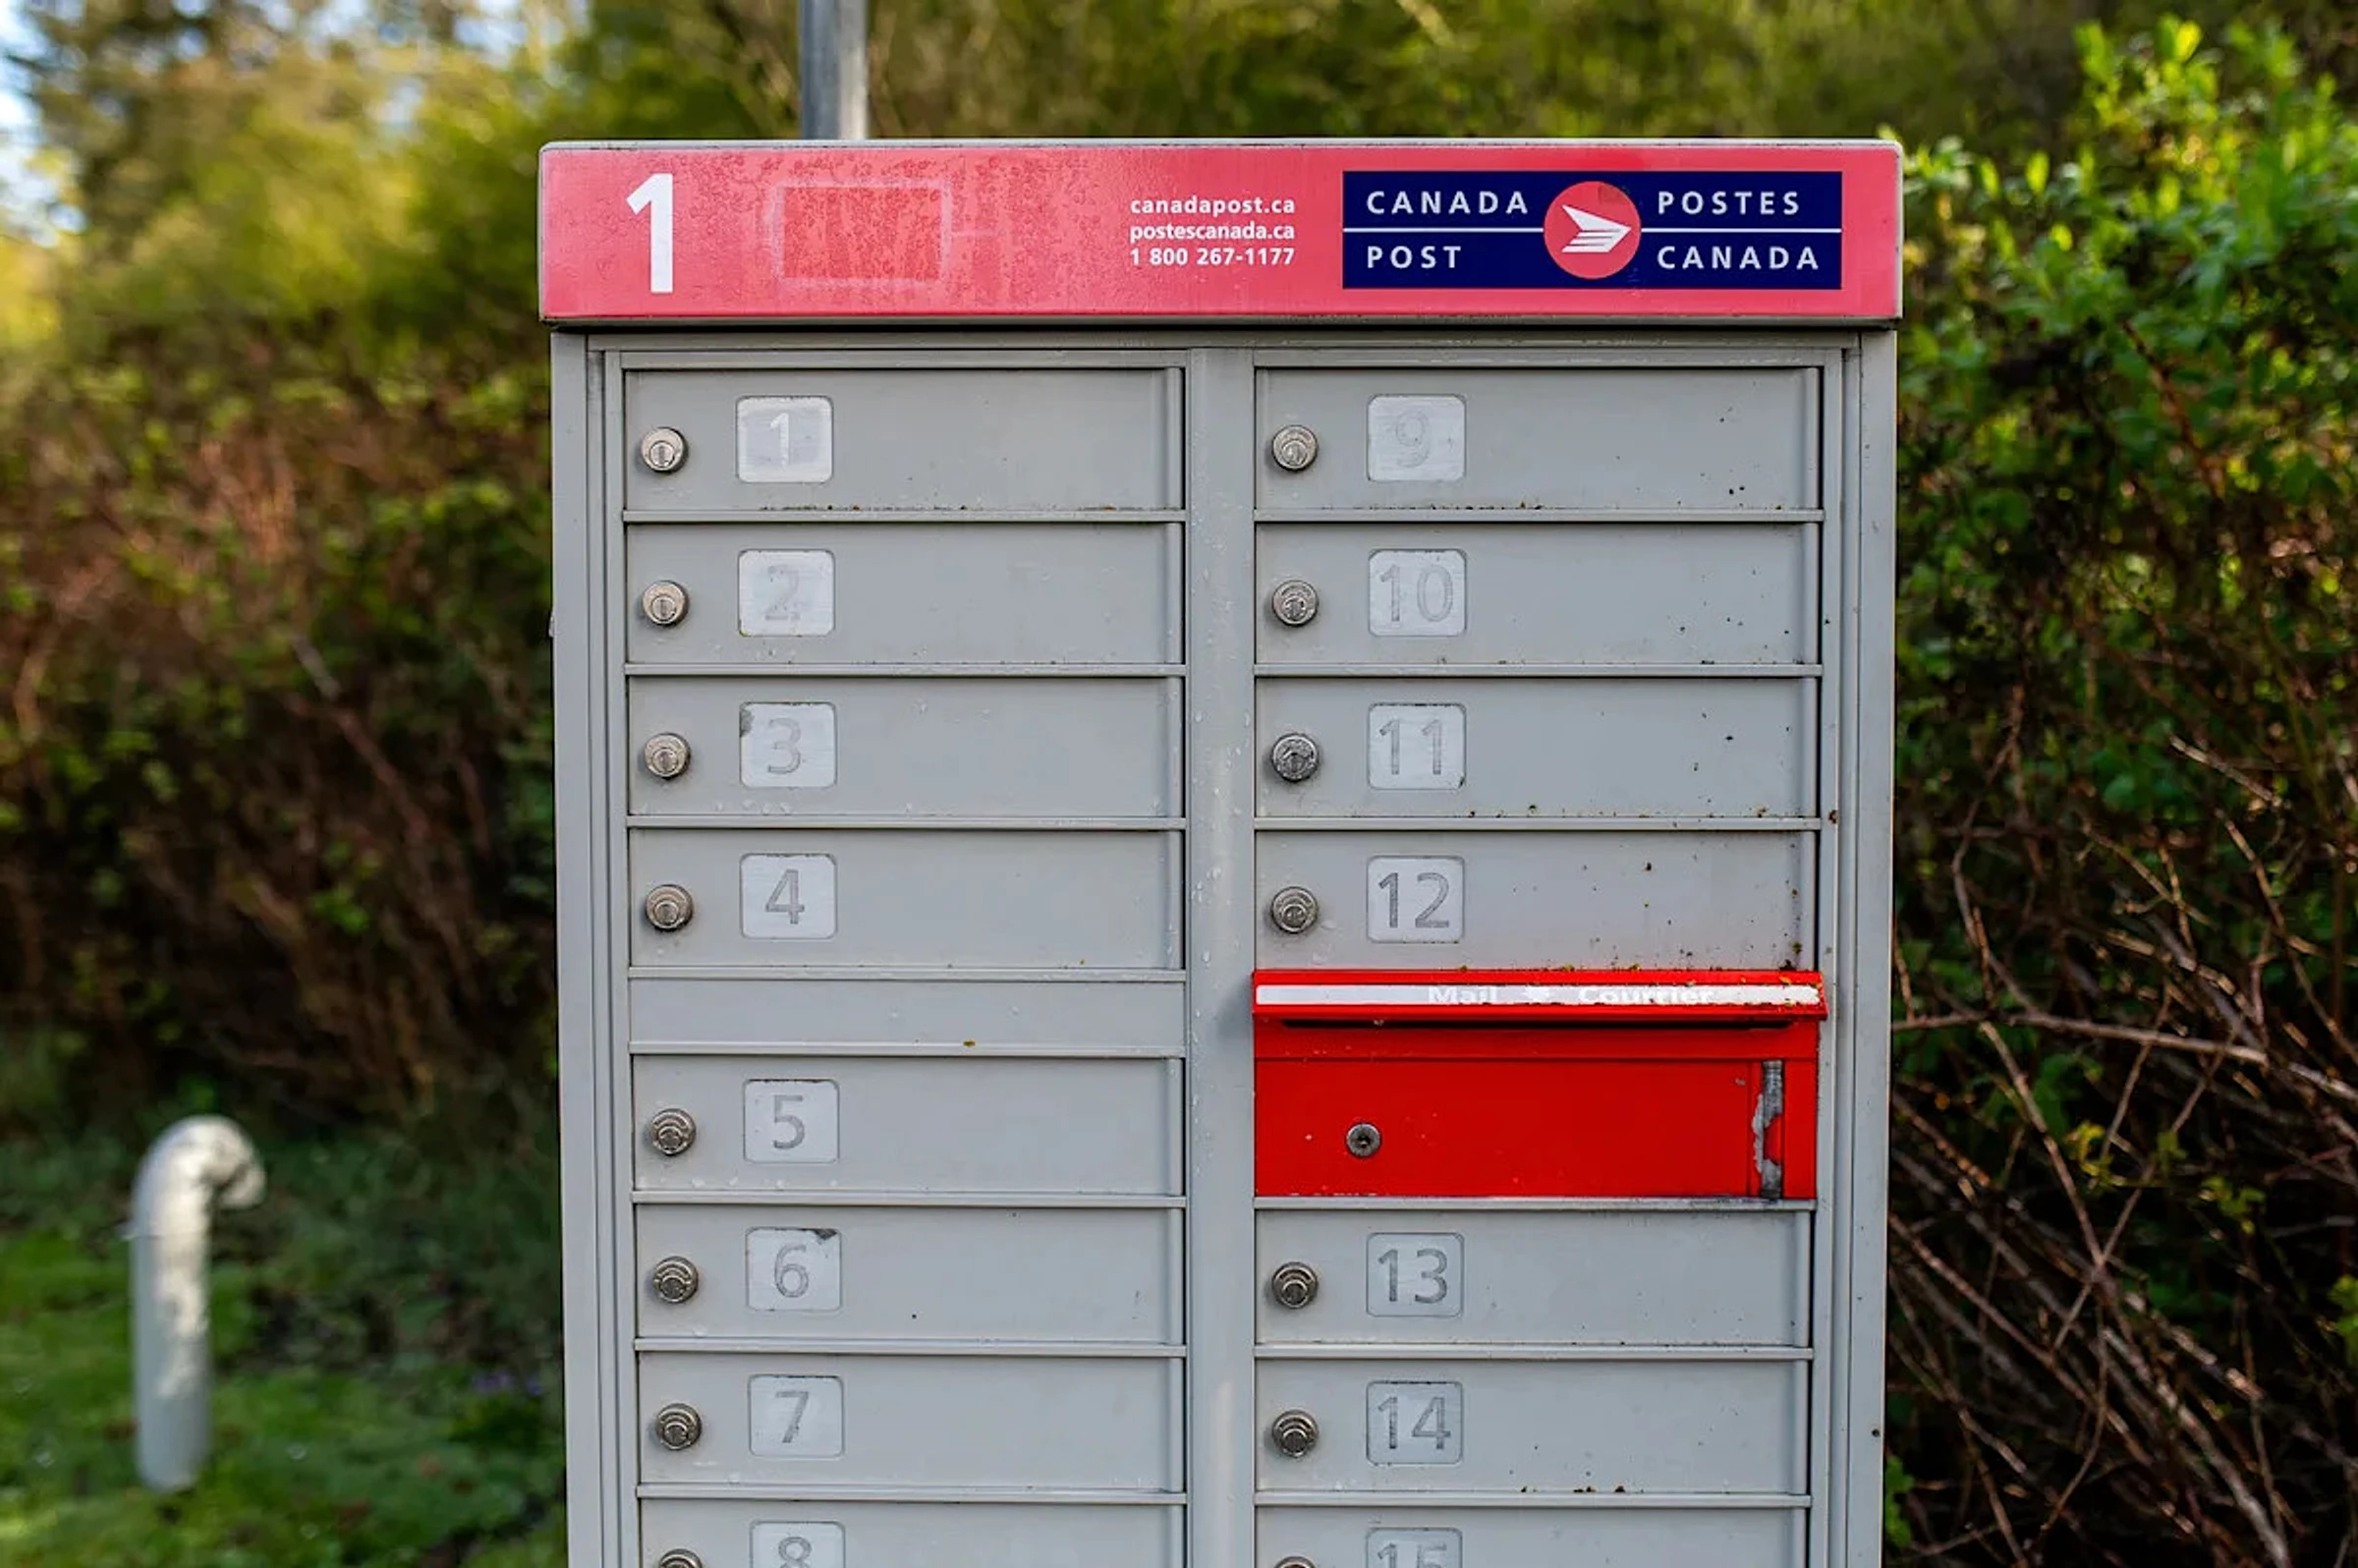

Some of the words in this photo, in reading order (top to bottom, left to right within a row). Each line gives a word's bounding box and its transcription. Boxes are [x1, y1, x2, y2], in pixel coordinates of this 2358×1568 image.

[1131, 196, 1295, 217] canadapost.ca
[1367, 191, 1528, 214] CANADA
[1657, 191, 1799, 215] POSTES
[626, 173, 674, 293] 1
[1130, 221, 1295, 244] postescanada.ca
[1131, 248, 1140, 265] 1
[1150, 248, 1189, 265] 800
[1197, 248, 1295, 265] 267-1177
[1367, 246, 1462, 268] POST
[1656, 246, 1819, 270] CANADA
[768, 412, 792, 469] 1
[1394, 411, 1430, 467] 9
[765, 564, 801, 620] 2
[1378, 564, 1454, 622] 10
[766, 718, 802, 775] 3
[1378, 718, 1444, 775] 11
[765, 869, 806, 924] 4
[1377, 872, 1449, 928] 12
[1428, 984, 1497, 1004] Mail
[1578, 984, 1714, 1004] Courrier
[772, 1094, 805, 1149] 5
[773, 1244, 810, 1299] 6
[1377, 1249, 1448, 1305] 13
[774, 1390, 810, 1443] 7
[1377, 1396, 1451, 1450] 14
